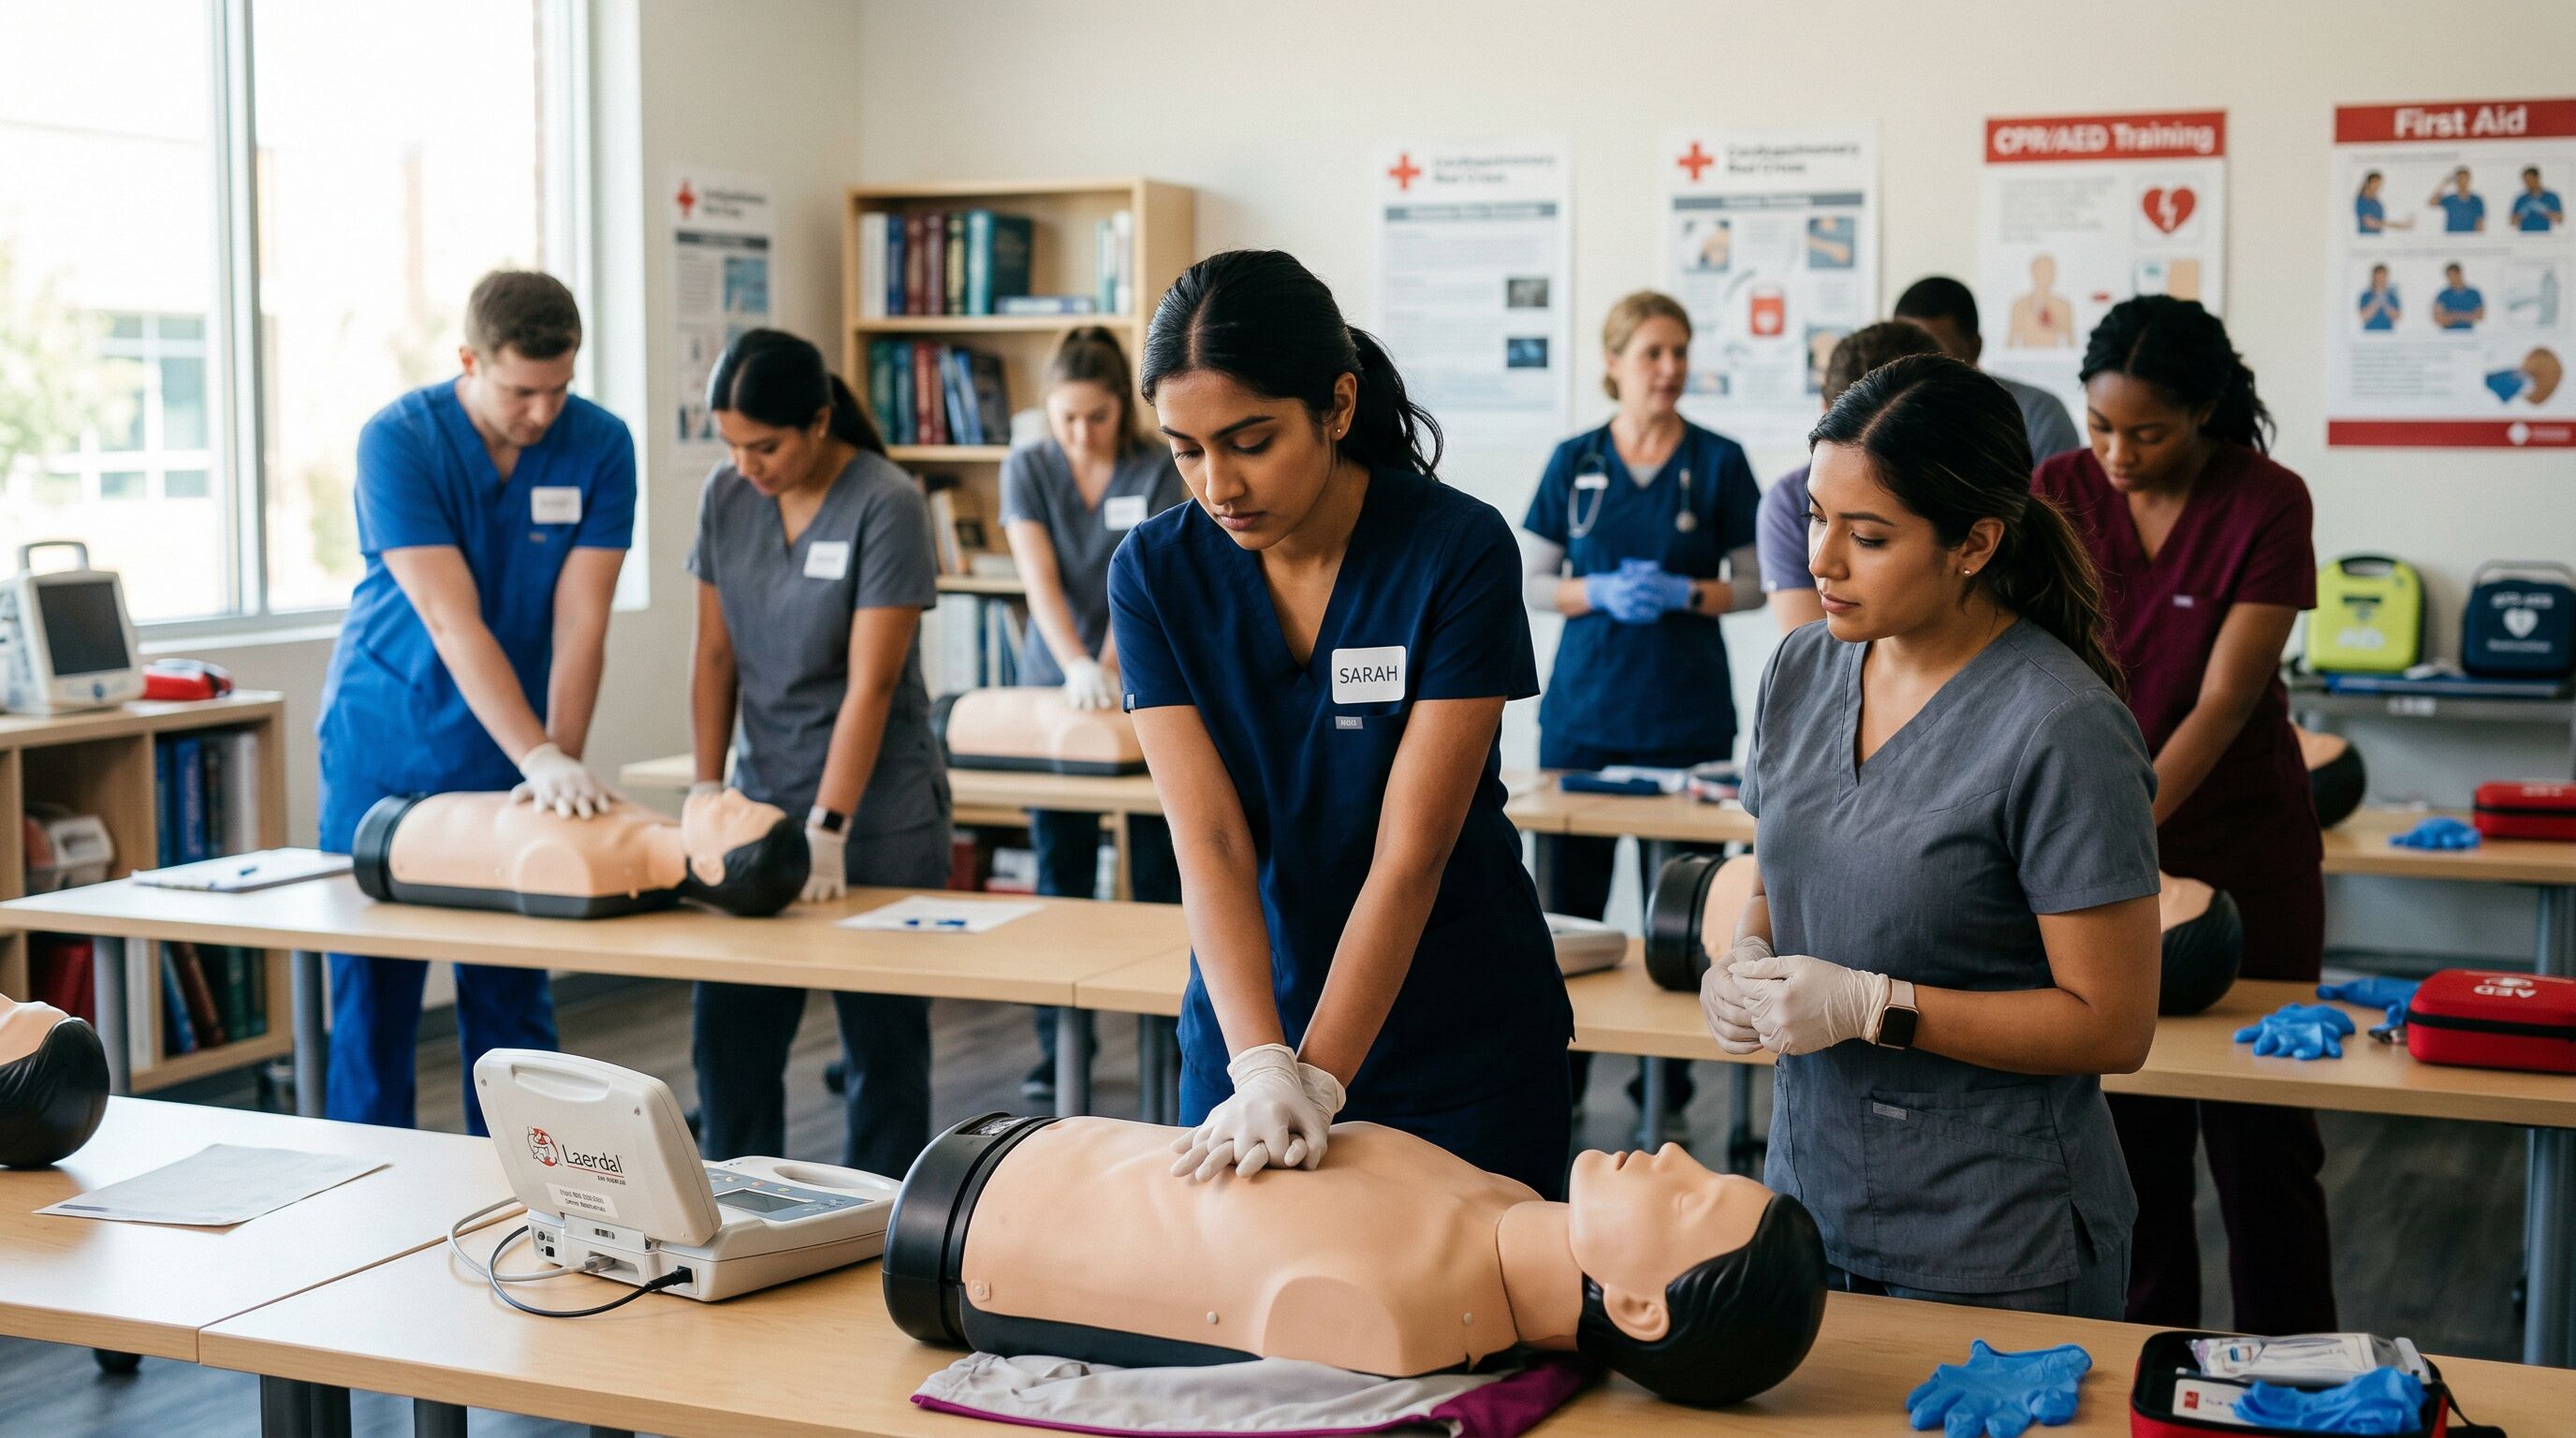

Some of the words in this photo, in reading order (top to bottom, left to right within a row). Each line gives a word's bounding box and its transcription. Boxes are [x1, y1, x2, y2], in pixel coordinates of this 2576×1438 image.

[2394, 108, 2466, 138] First
[2472, 105, 2527, 136] Aid
[1995, 124, 2109, 155] CPR/AED
[2112, 121, 2215, 154] Training
[1339, 666, 1398, 683] SARAH
[2473, 984, 2538, 999] AED
[562, 1144, 623, 1174] Laerdal
